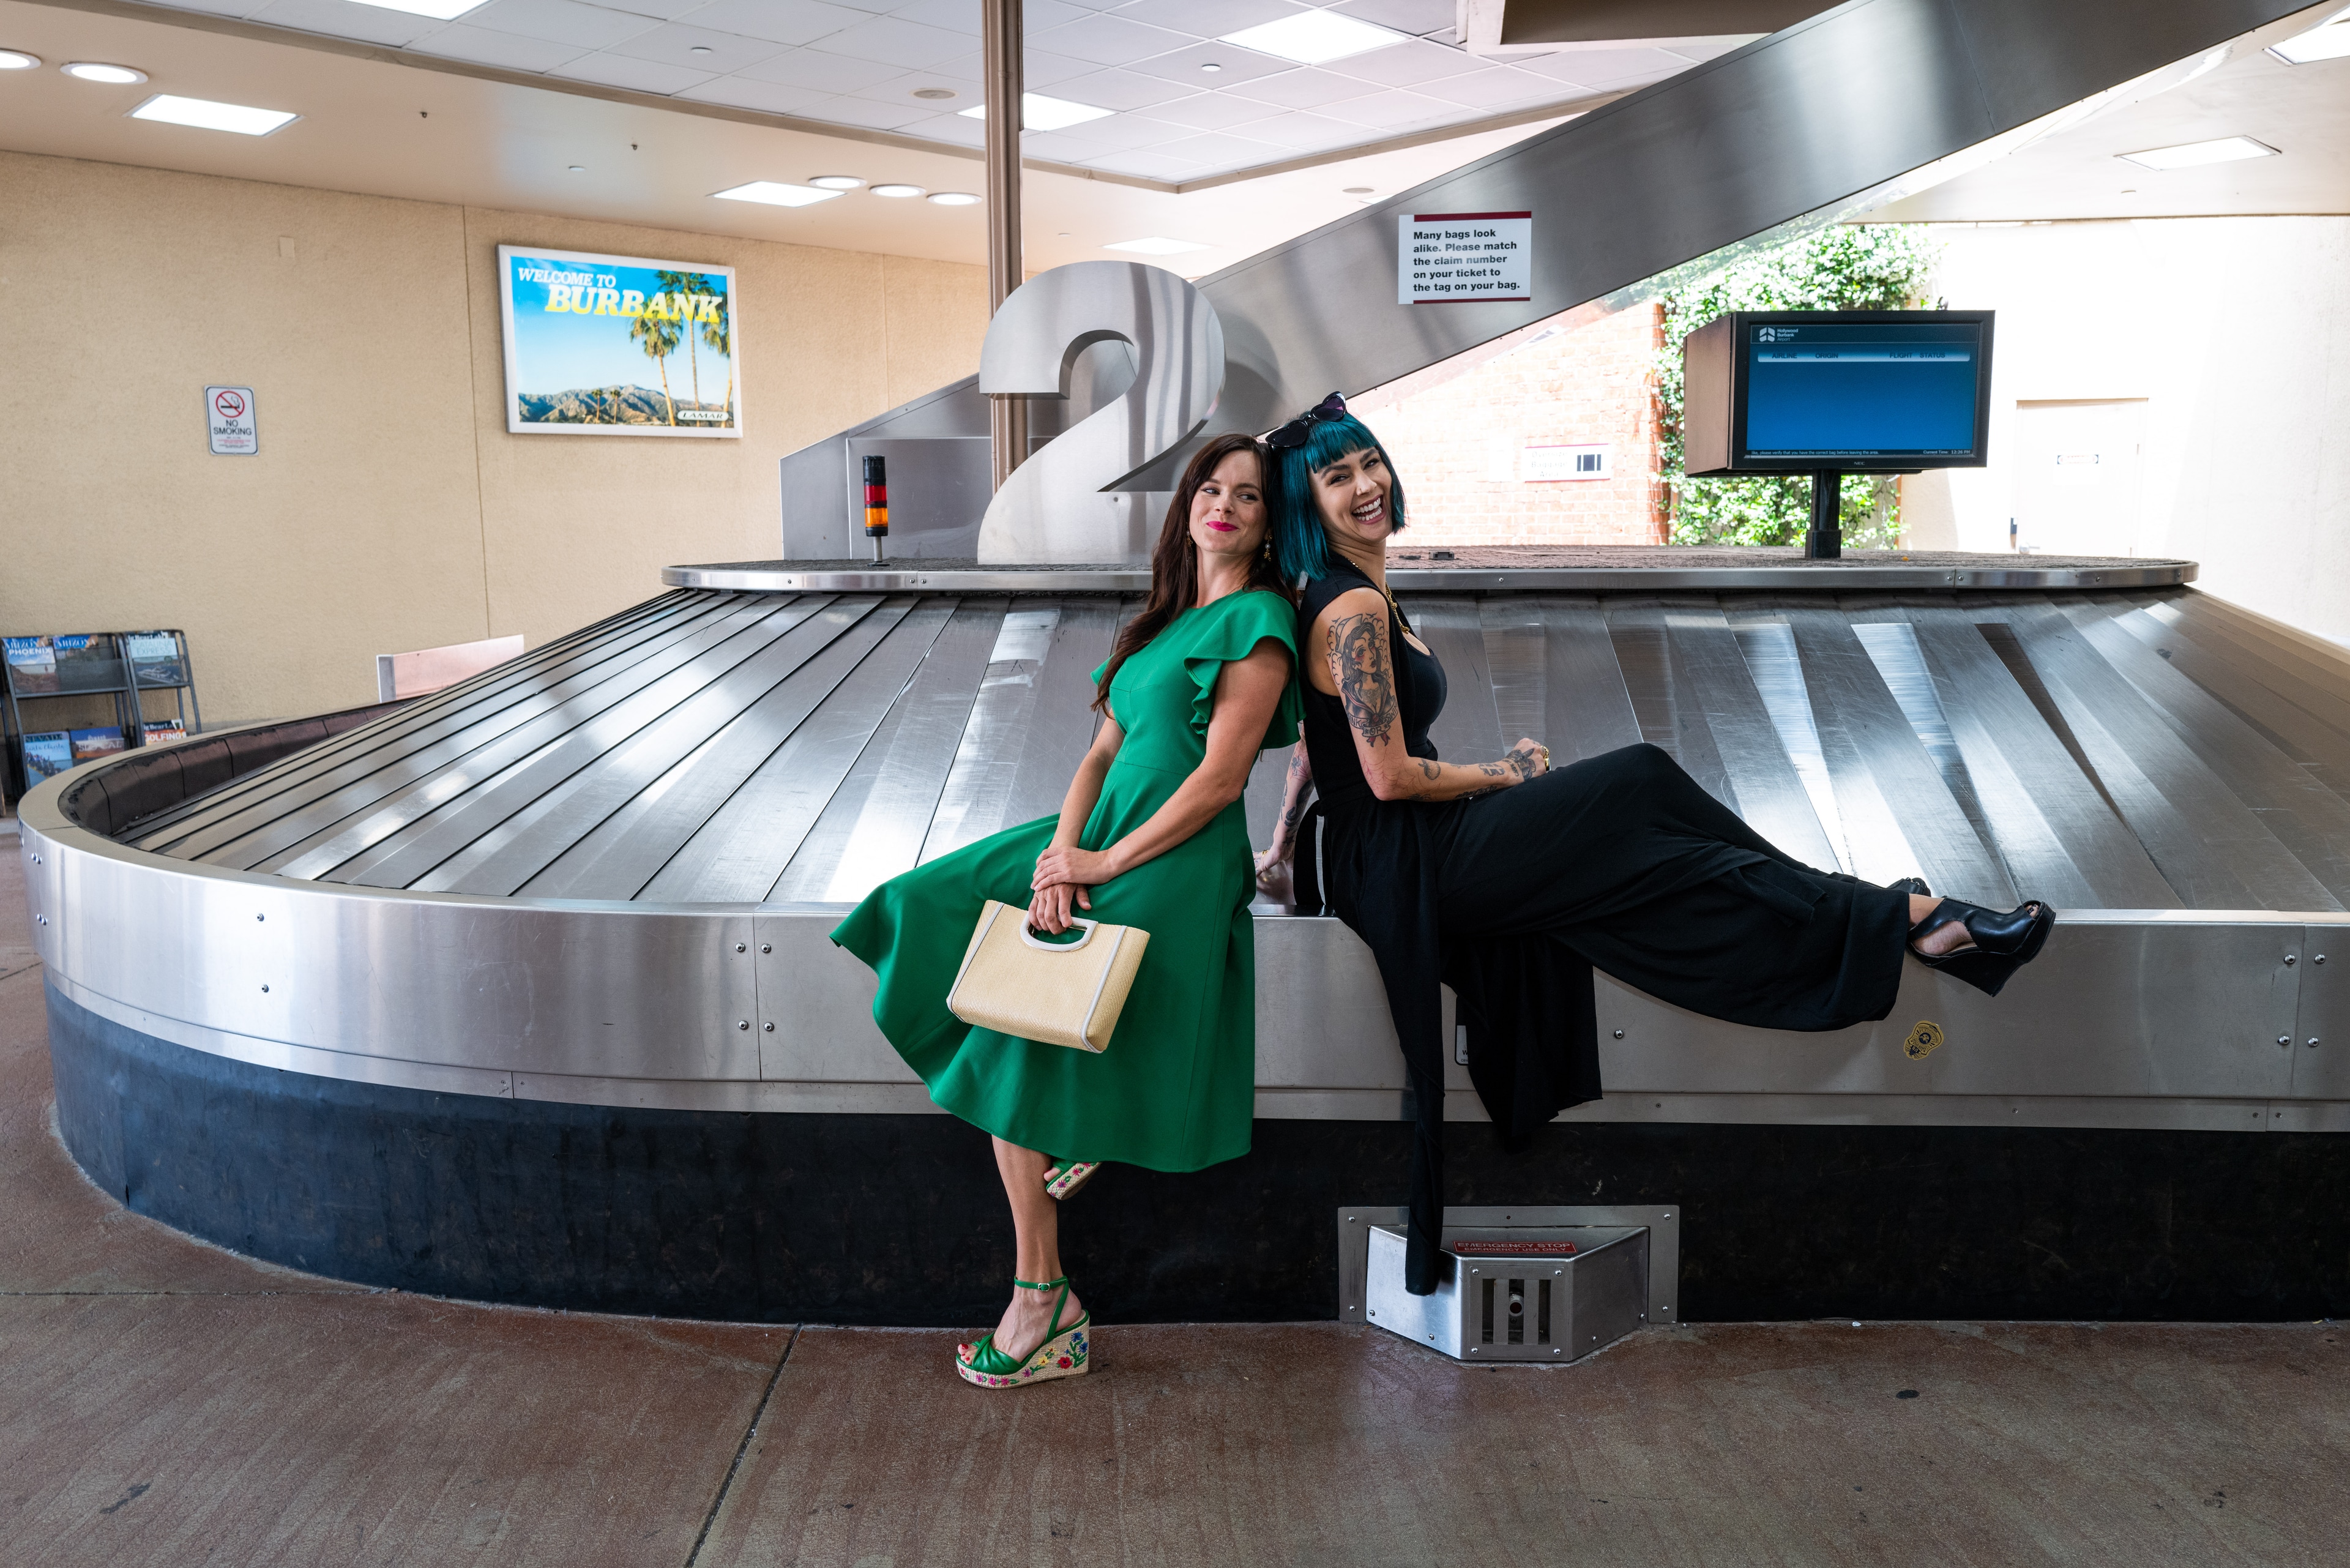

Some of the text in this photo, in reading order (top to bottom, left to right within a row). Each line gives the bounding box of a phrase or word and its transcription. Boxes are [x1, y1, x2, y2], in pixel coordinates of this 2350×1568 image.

[1414, 229, 1496, 240] Many bags look
[1414, 241, 1517, 253] alike. Please match
[1414, 255, 1507, 266] the claim number
[518, 267, 616, 288] WELCOME TO
[1430, 270, 1453, 280] your
[1457, 269, 1486, 277] ticket
[1434, 283, 1451, 292] tag
[1471, 283, 1494, 291] your
[1498, 281, 1520, 291] bag.
[545, 284, 723, 323] BURBANK
[977, 260, 1226, 565] 2
[58, 638, 96, 648] ARIZONA
[1370, 726, 1386, 736] OR
